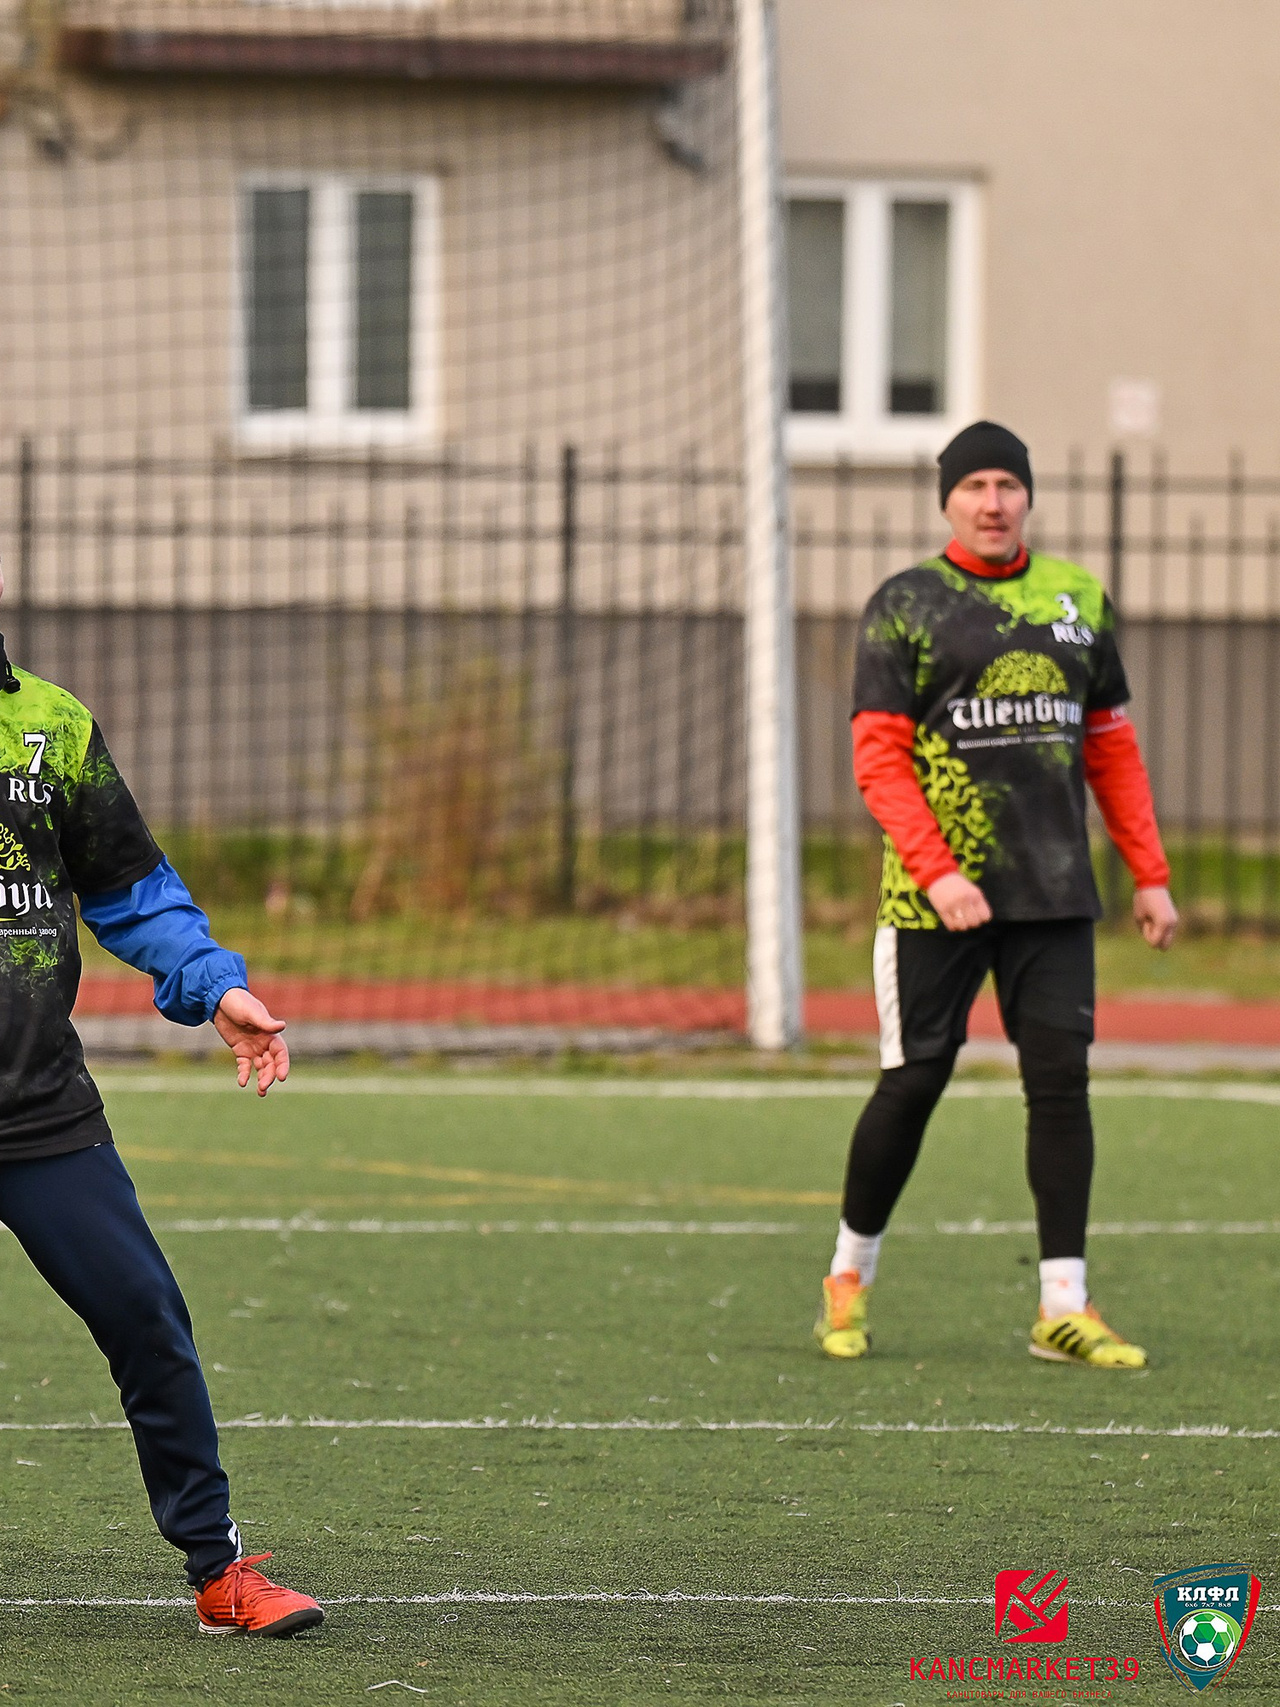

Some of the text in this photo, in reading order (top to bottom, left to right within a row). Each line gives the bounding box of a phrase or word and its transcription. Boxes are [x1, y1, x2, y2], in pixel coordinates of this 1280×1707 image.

[1055, 593, 1079, 624] 3
[1051, 622, 1095, 647] RUS
[23, 733, 47, 775] 7
[8, 777, 55, 805] RUS
